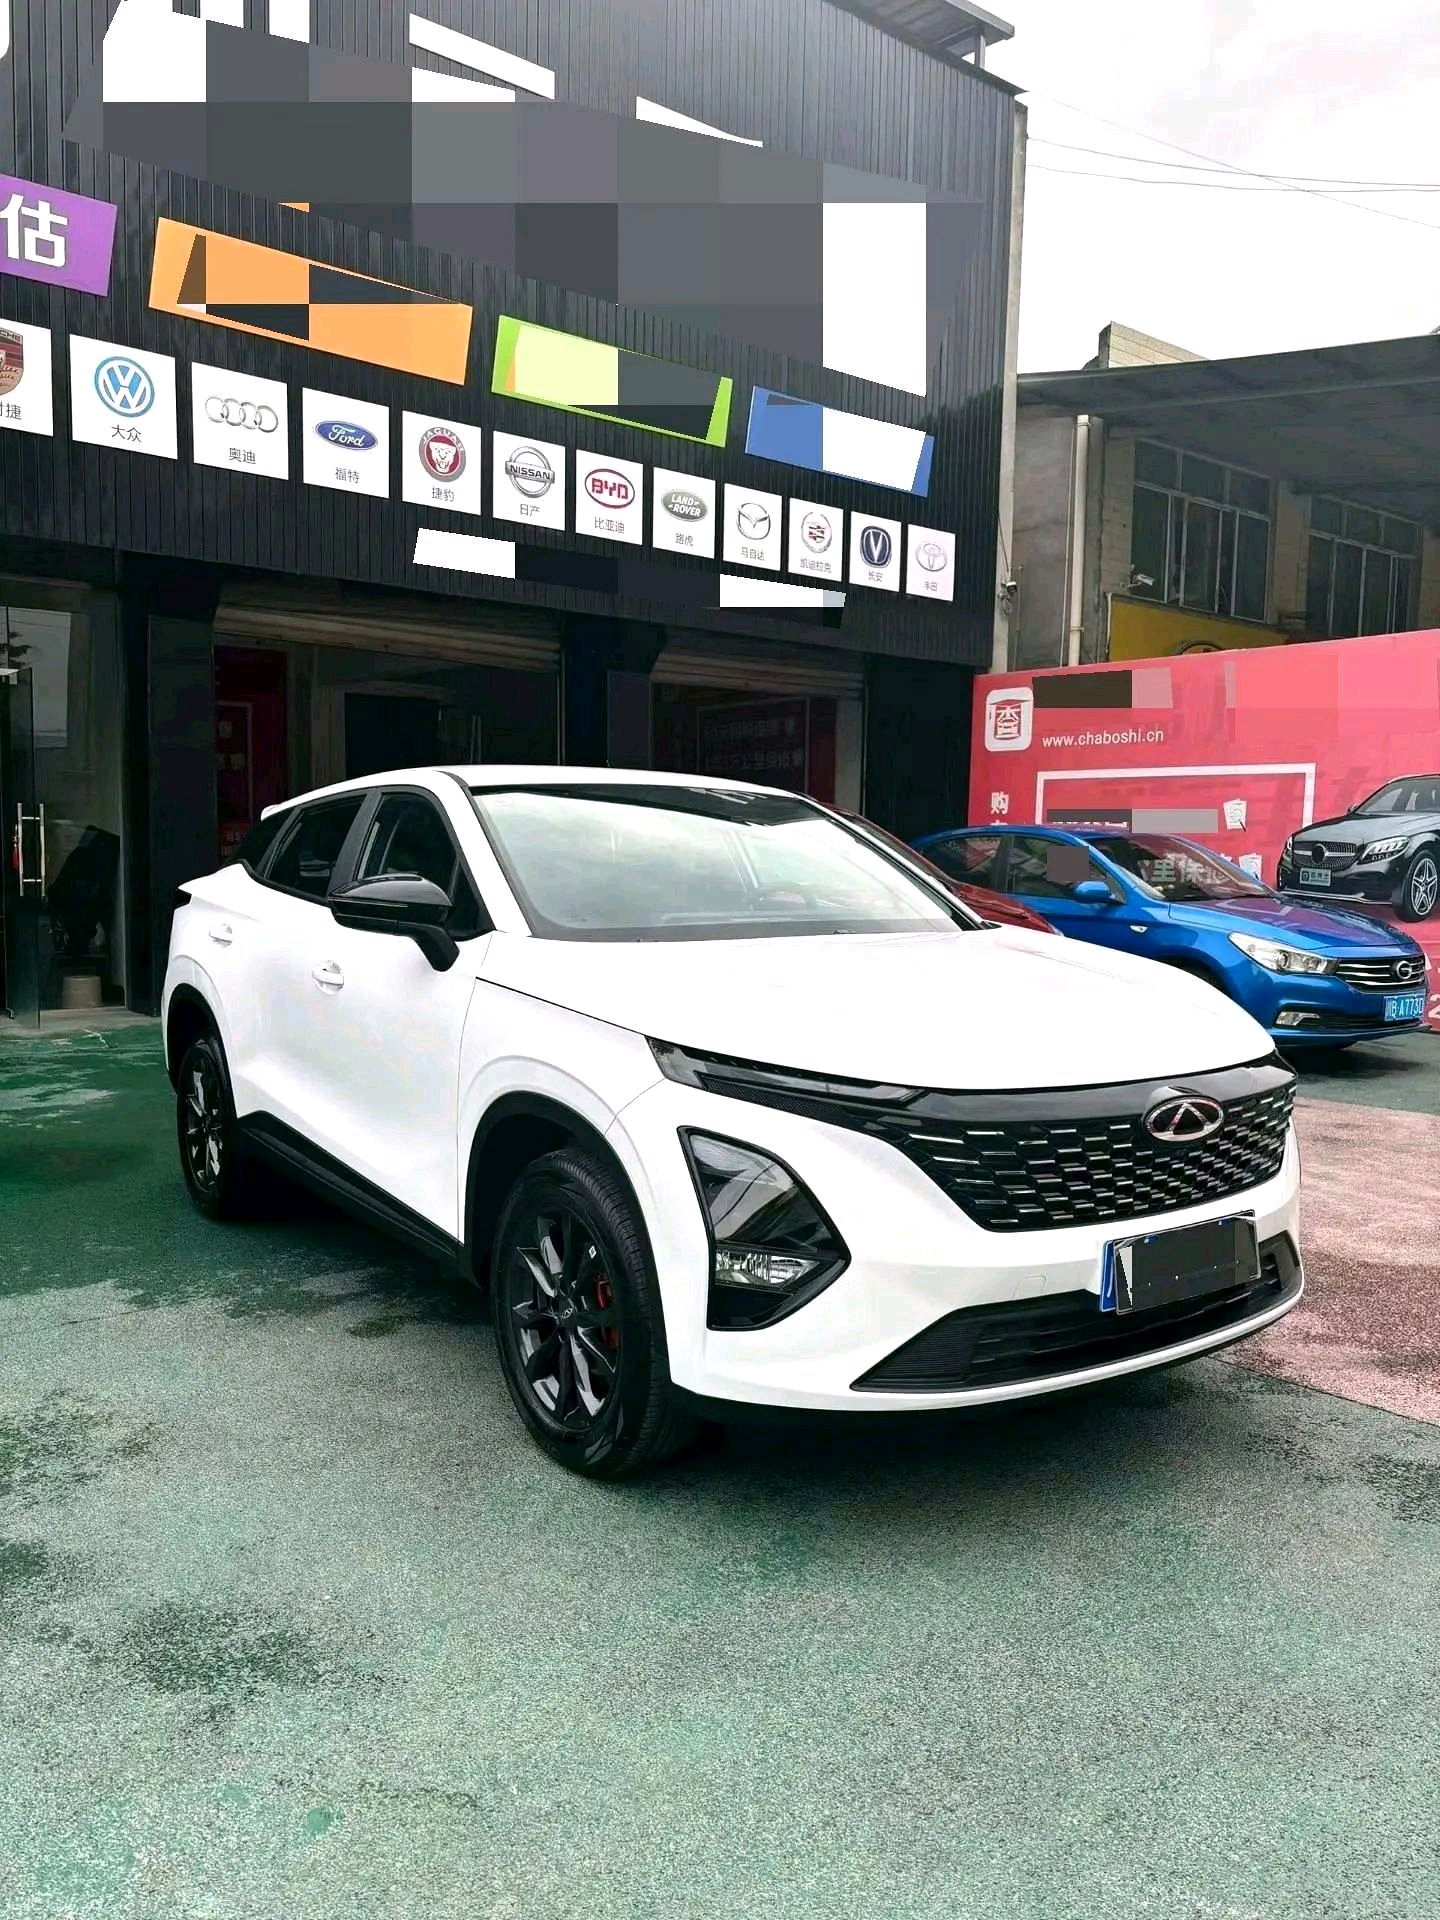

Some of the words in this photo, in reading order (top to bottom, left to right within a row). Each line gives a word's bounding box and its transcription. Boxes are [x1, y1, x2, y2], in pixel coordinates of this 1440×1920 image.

[0, 193, 68, 268] 估
[111, 424, 142, 443] 大众
[328, 424, 365, 447] Ford
[229, 447, 256, 465] 奥迪
[335, 467, 360, 484] 福特
[510, 464, 551, 480] NISSAN
[432, 486, 455, 502] 捷豹
[591, 477, 629, 500] BYD
[671, 493, 694, 507] LAND
[520, 503, 540, 517] 日产
[673, 504, 701, 517] ROVER
[594, 516, 625, 535] 比亚迪
[675, 532, 694, 547] 路虎
[741, 546, 765, 561] 马自达
[1042, 729, 1164, 748] www.chaboshi.cn
